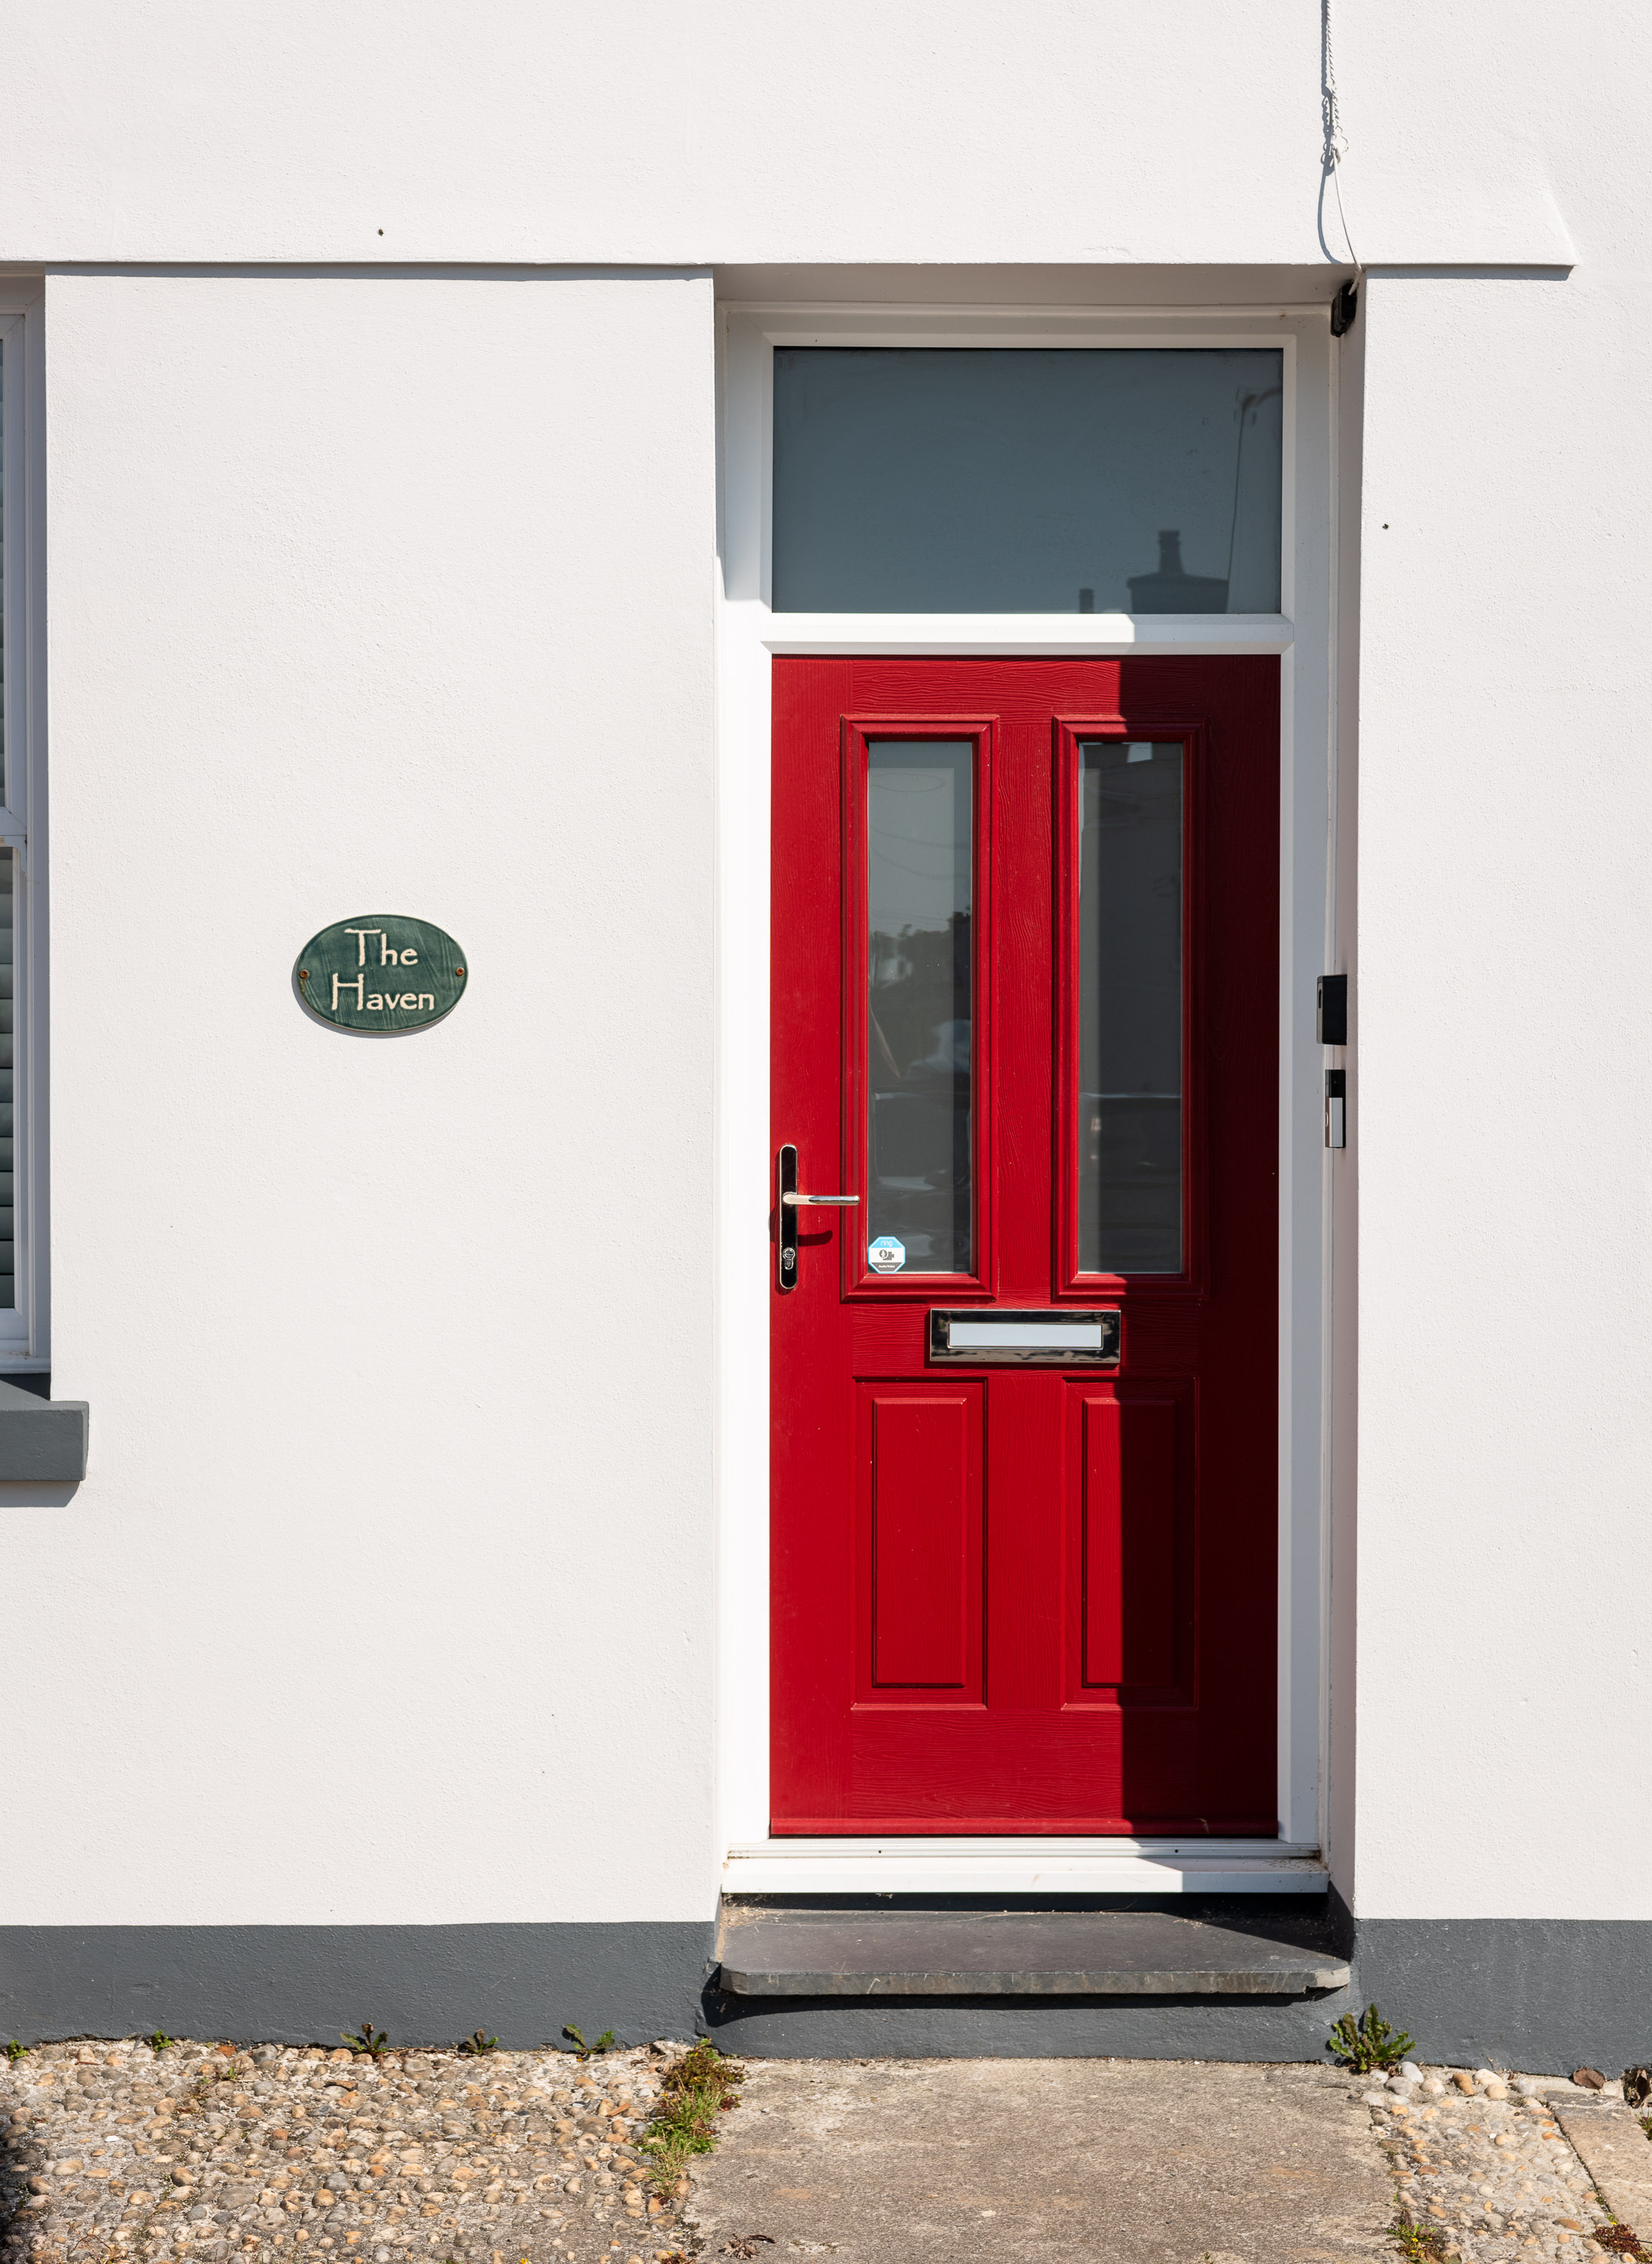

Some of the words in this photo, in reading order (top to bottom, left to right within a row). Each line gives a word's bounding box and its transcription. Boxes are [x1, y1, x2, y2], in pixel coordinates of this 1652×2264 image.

[344, 928, 418, 966] The
[331, 973, 435, 1010] Haven
[880, 1239, 893, 1247] ring
